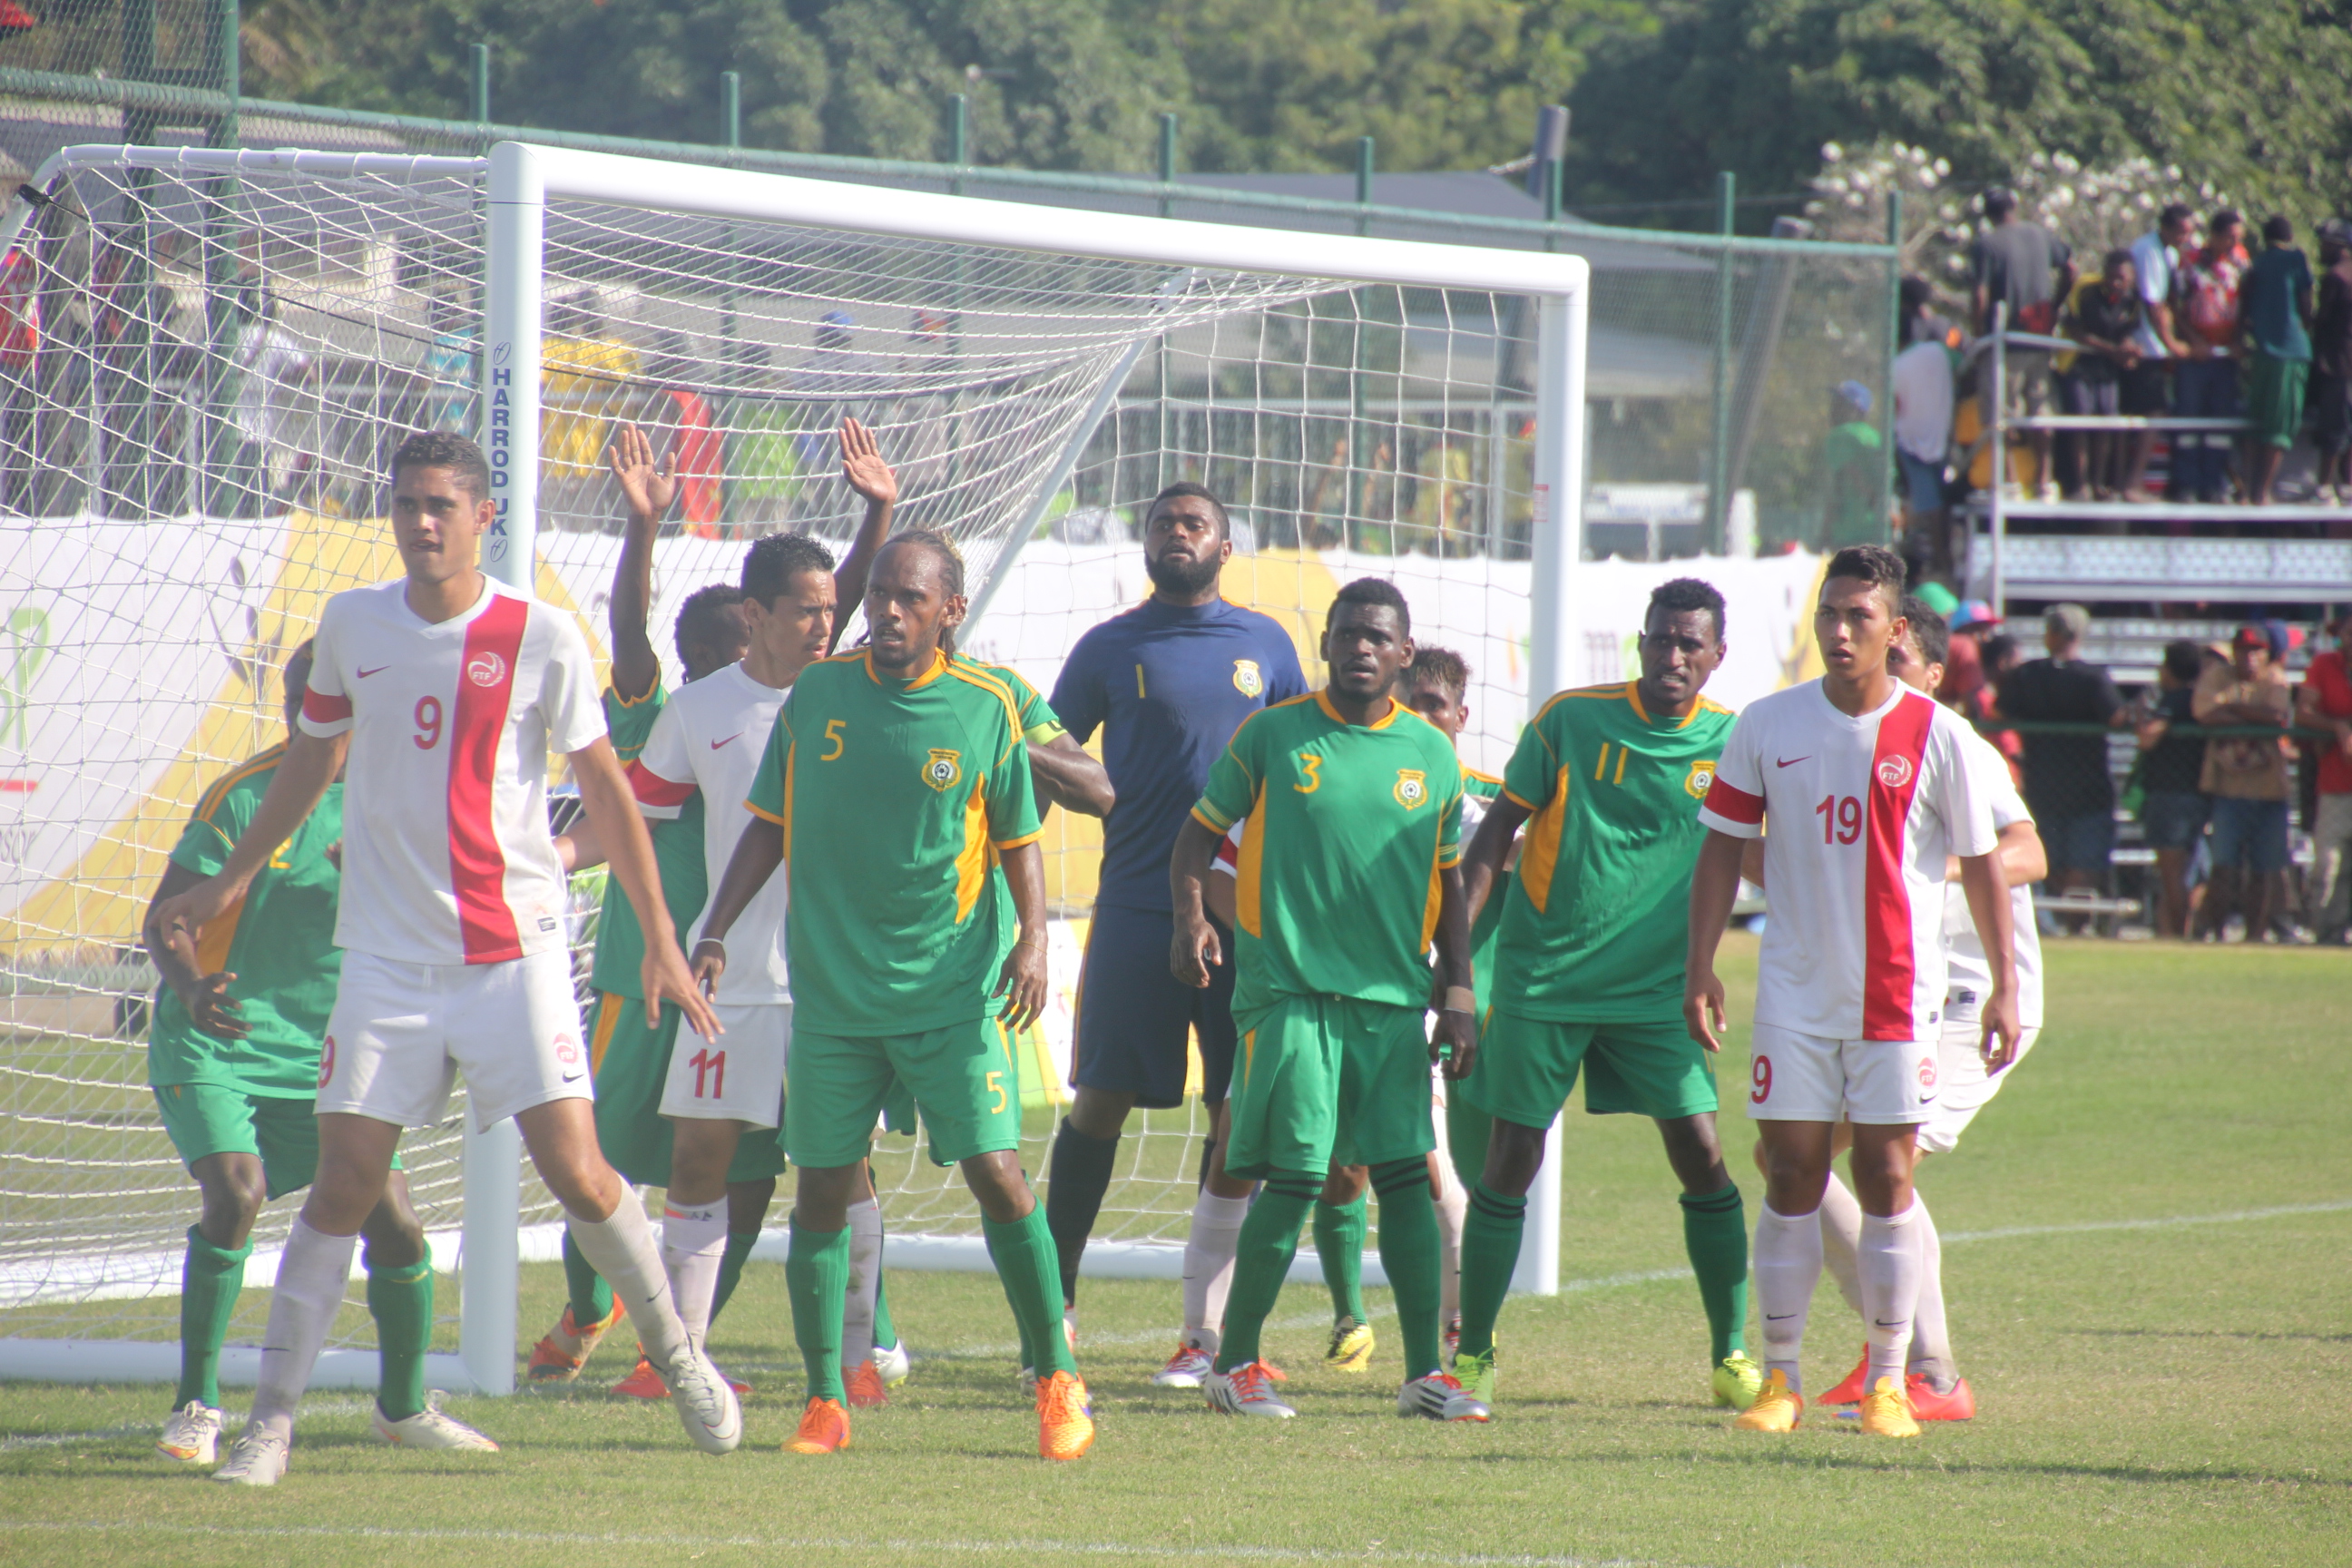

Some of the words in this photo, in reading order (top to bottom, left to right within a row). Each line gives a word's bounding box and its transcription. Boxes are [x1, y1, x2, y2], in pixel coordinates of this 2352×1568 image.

[490, 368, 511, 488] HARROD
[490, 497, 508, 536] UK
[472, 671, 491, 681] FTF
[413, 694, 443, 750] 9
[820, 719, 847, 761] 5
[1293, 753, 1323, 794] 3
[1594, 742, 1629, 785] 11
[1882, 771, 1899, 781] FTF
[1816, 794, 1863, 846] 19
[318, 1034, 336, 1089] 9
[689, 1048, 726, 1099] 11
[1749, 1054, 1772, 1104] 9
[985, 1071, 1007, 1114] 5
